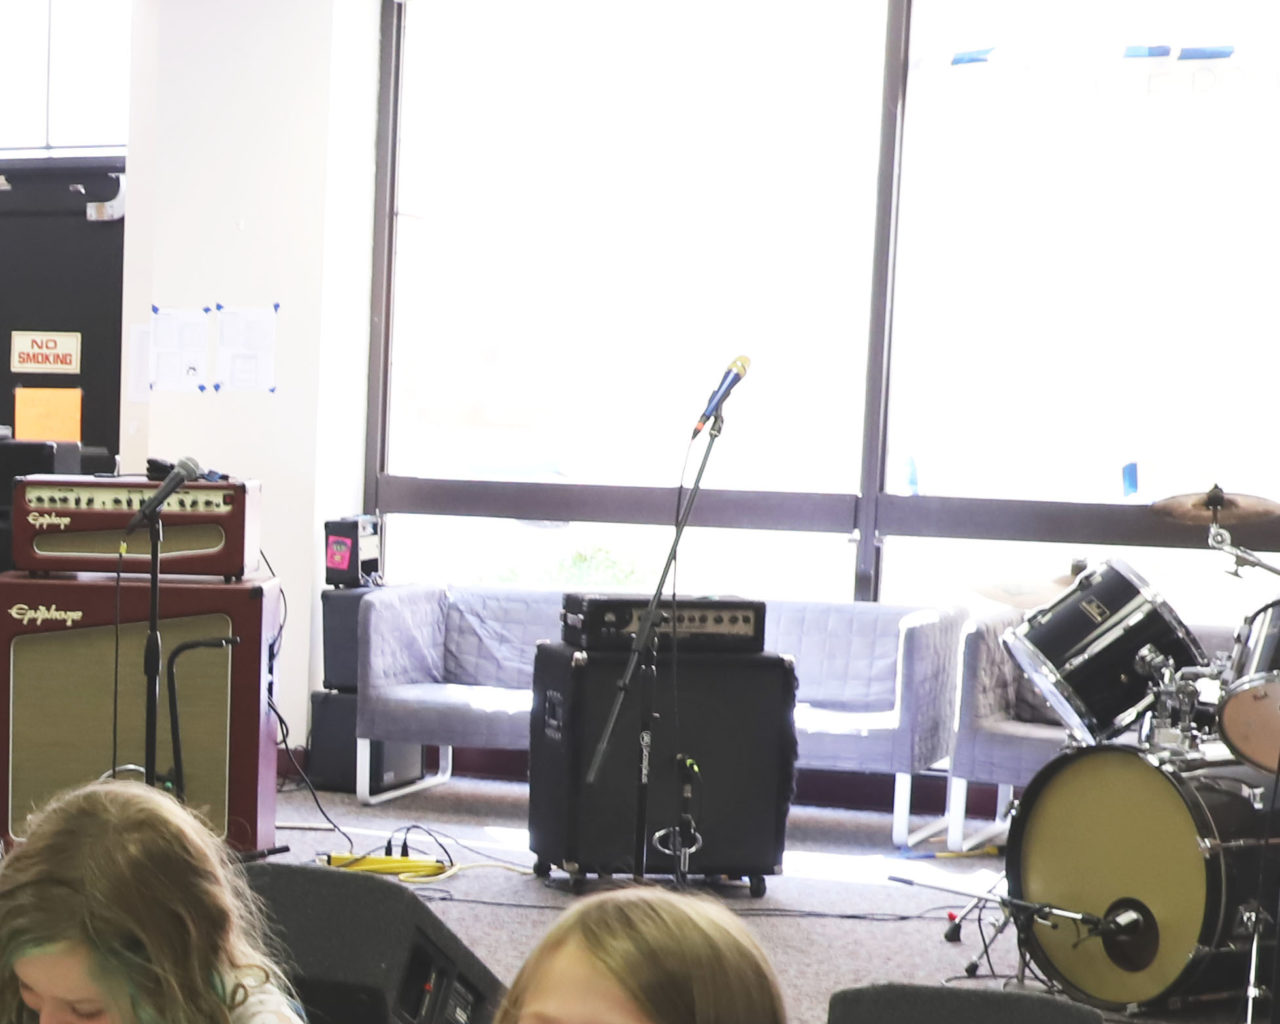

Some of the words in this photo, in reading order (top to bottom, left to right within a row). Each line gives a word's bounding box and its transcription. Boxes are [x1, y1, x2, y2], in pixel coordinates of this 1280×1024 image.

[31, 339, 58, 350] NO
[18, 352, 73, 366] SMOKING
[7, 603, 83, 627] Epiphone
